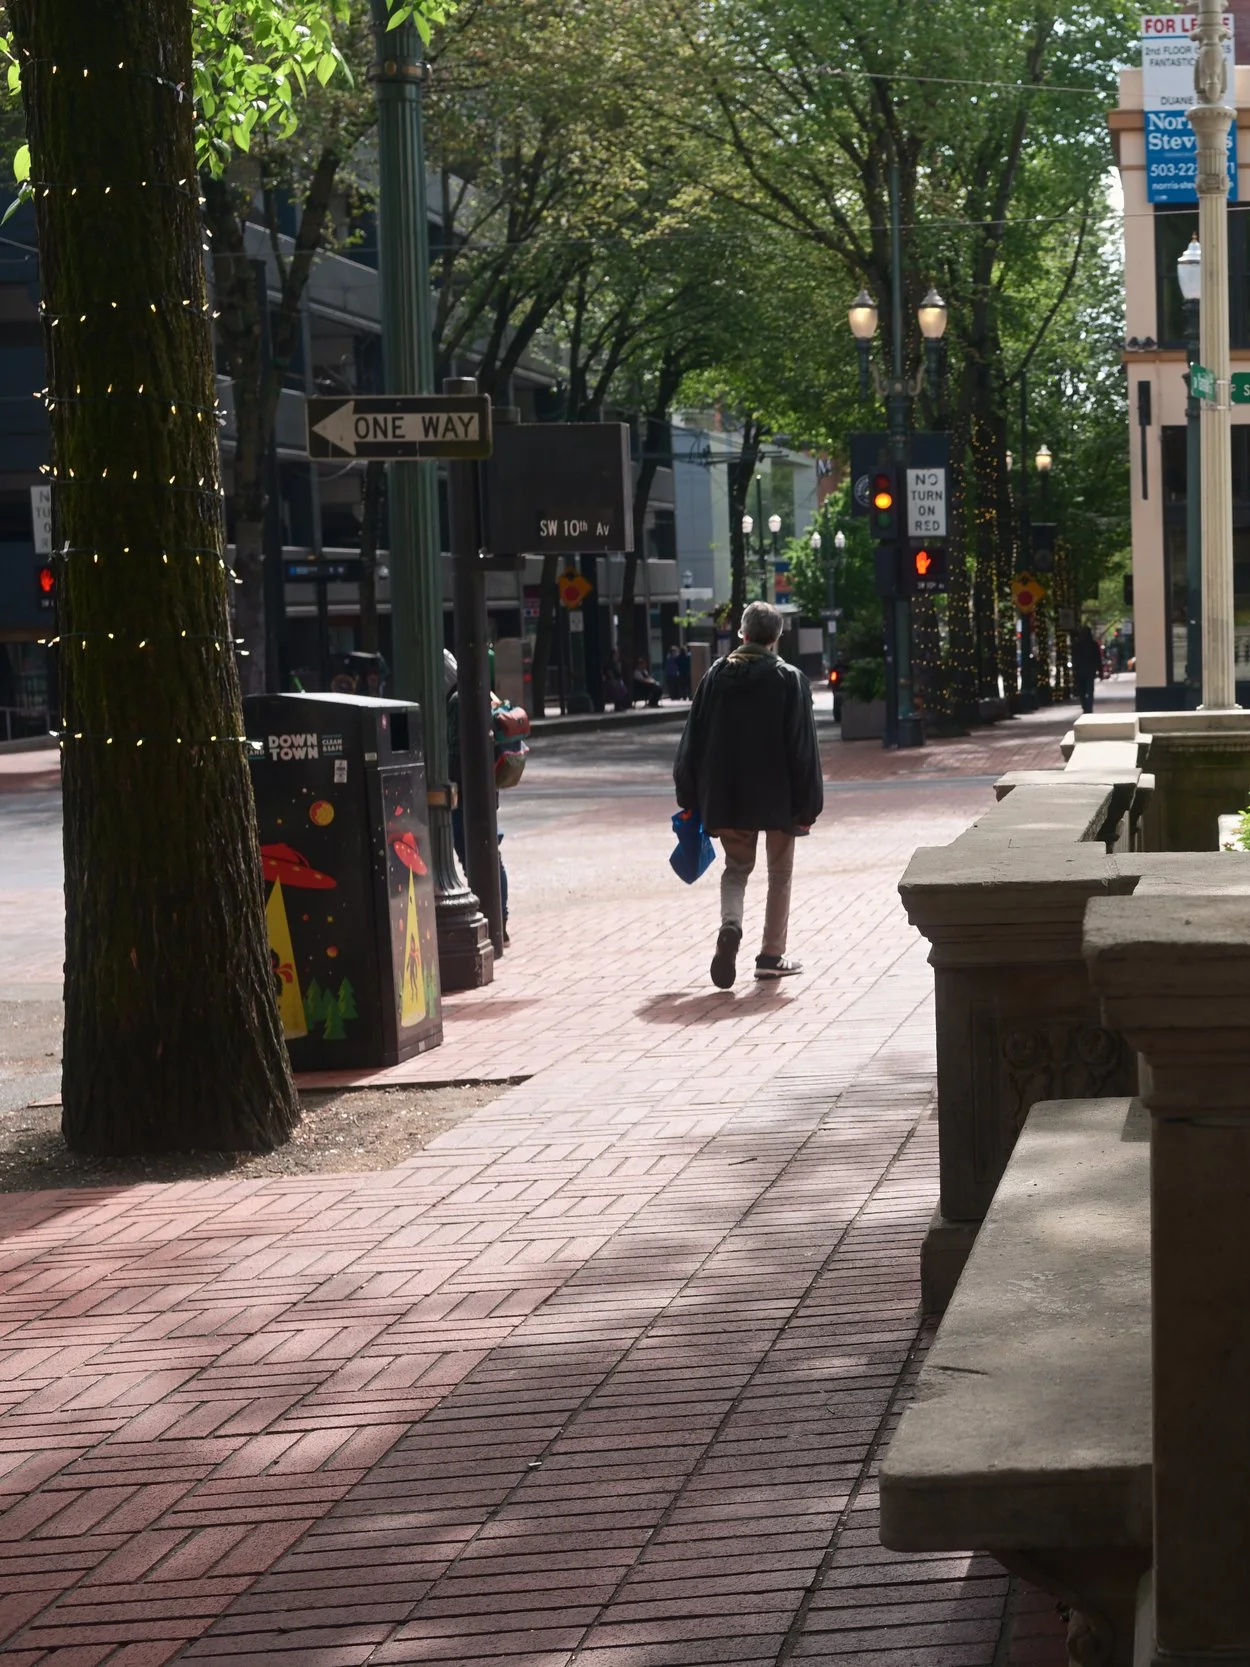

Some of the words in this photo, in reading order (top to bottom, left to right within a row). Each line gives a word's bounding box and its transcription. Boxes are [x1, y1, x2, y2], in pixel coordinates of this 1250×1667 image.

[1145, 18, 1176, 33] FOR
[1181, 17, 1230, 32] LEE
[1163, 46, 1193, 54] FLOOR
[1149, 58, 1195, 67] FANTASTIC
[1160, 96, 1194, 105] DUANE
[1148, 132, 1234, 150] Stevs
[354, 416, 405, 440] ONE
[422, 415, 474, 438] WAY
[915, 474, 938, 486] NO
[40, 491, 50, 503] N
[911, 490, 943, 501] TURN
[918, 505, 936, 516] ON
[540, 519, 558, 537] SW
[563, 519, 588, 537] 10th
[596, 521, 610, 536] Av
[915, 520, 941, 532] RED
[268, 734, 317, 748] DOWN
[269, 747, 319, 761] TOWN
